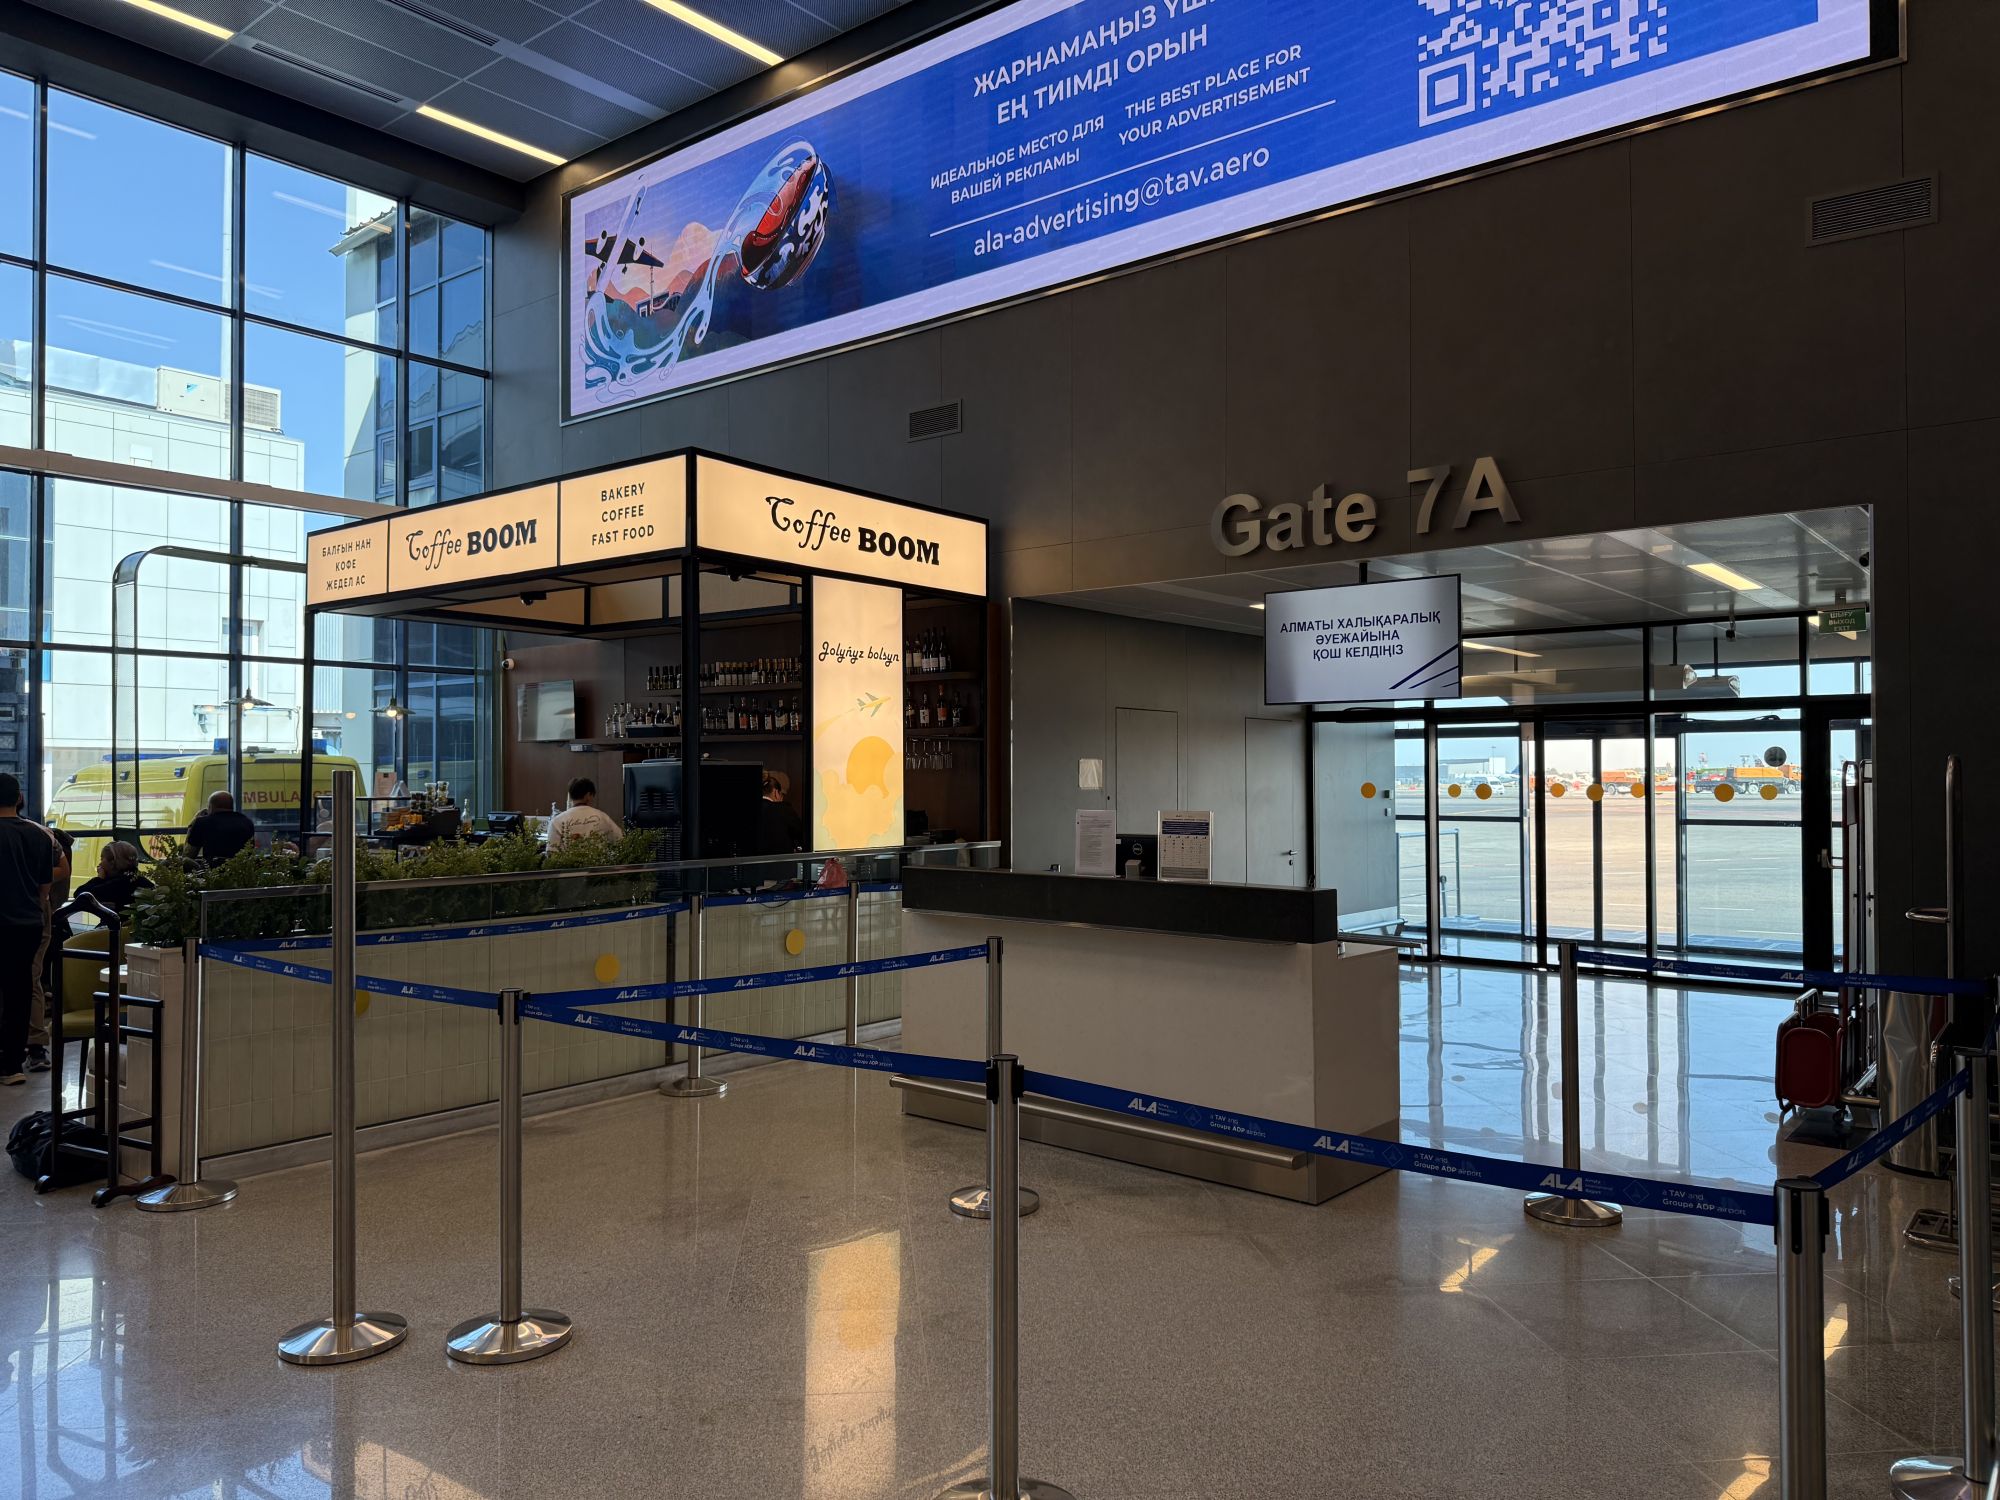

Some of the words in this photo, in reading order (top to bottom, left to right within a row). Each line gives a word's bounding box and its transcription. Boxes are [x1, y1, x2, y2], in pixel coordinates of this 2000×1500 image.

[973, 5, 1156, 97] ЖАРНАМАҢЫЗ
[997, 94, 1029, 124] ЕҢ
[1033, 58, 1119, 109] ТИІМДІ
[1126, 24, 1207, 73] ОРЫН
[1125, 96, 1156, 119] THE
[1160, 80, 1200, 107] BEST
[1205, 59, 1260, 92] PLACE
[1265, 44, 1302, 70] FOR
[1118, 119, 1162, 145] YOUR
[1166, 67, 1311, 130] ADVERTISEMENT
[930, 148, 1015, 190] ИДЕАЛЬНОЕ
[1019, 129, 1068, 158] МЕСТО
[1072, 115, 1104, 142] ДЛЯ
[951, 173, 1002, 205] ВАШЕЙ
[1006, 148, 1080, 186] РЕКЛАМЫ
[973, 147, 1270, 256] ala-advertising@tav.aero
[601, 482, 645, 502] BAKERY
[601, 504, 645, 522] COFFEE
[1210, 483, 1378, 557] Gate
[1407, 456, 1522, 534] 7A
[592, 530, 618, 546] FAST
[623, 525, 654, 540] FOOD
[765, 496, 851, 551] Coffee
[858, 527, 940, 566] BOOM
[322, 541, 353, 557] БАЛҒЫН
[355, 538, 371, 551] НАН
[406, 528, 462, 571] Coffee
[467, 519, 537, 556] BOOM
[335, 559, 356, 572] КОФЕ
[326, 577, 353, 591] ЖЕДЕЛ
[355, 575, 366, 586] АС
[1280, 619, 1334, 633] АЛМАТЫ
[1337, 611, 1441, 629] ХАЛЫҚАРАЛЫҚ
[1828, 618, 1855, 626] ВЫХОД
[1316, 629, 1400, 645] ӘУЕЖАЙЫНА
[867, 645, 900, 667] bolsyn
[1313, 648, 1341, 661] ҚОШ
[1345, 644, 1404, 659] КЕЛДІҢІЗ
[378, 935, 395, 944] ALA
[468, 928, 484, 937] ALA
[278, 940, 297, 949] ALA
[930, 953, 945, 963] ALA
[1652, 960, 1674, 971] ALA
[837, 965, 855, 975] ALA
[1780, 971, 1804, 981] ALA
[734, 977, 754, 988] ALA
[616, 989, 638, 1000] ALA
[575, 1013, 592, 1025] ALA
[678, 1029, 698, 1041] ALA
[794, 1045, 815, 1058] ALA
[1127, 1097, 1157, 1114] ALA
[1313, 1135, 1349, 1154] ALA
[1414, 1160, 1440, 1170] Groupe
[1441, 1165, 1457, 1173] ADP
[1540, 1173, 1583, 1192] ALA
[1668, 1189, 1686, 1198] TAV
[1688, 1193, 1704, 1201] and
[1662, 1198, 1694, 1209] Groupe
[1696, 1202, 1715, 1211] ADP
[1717, 1206, 1747, 1216] airport
